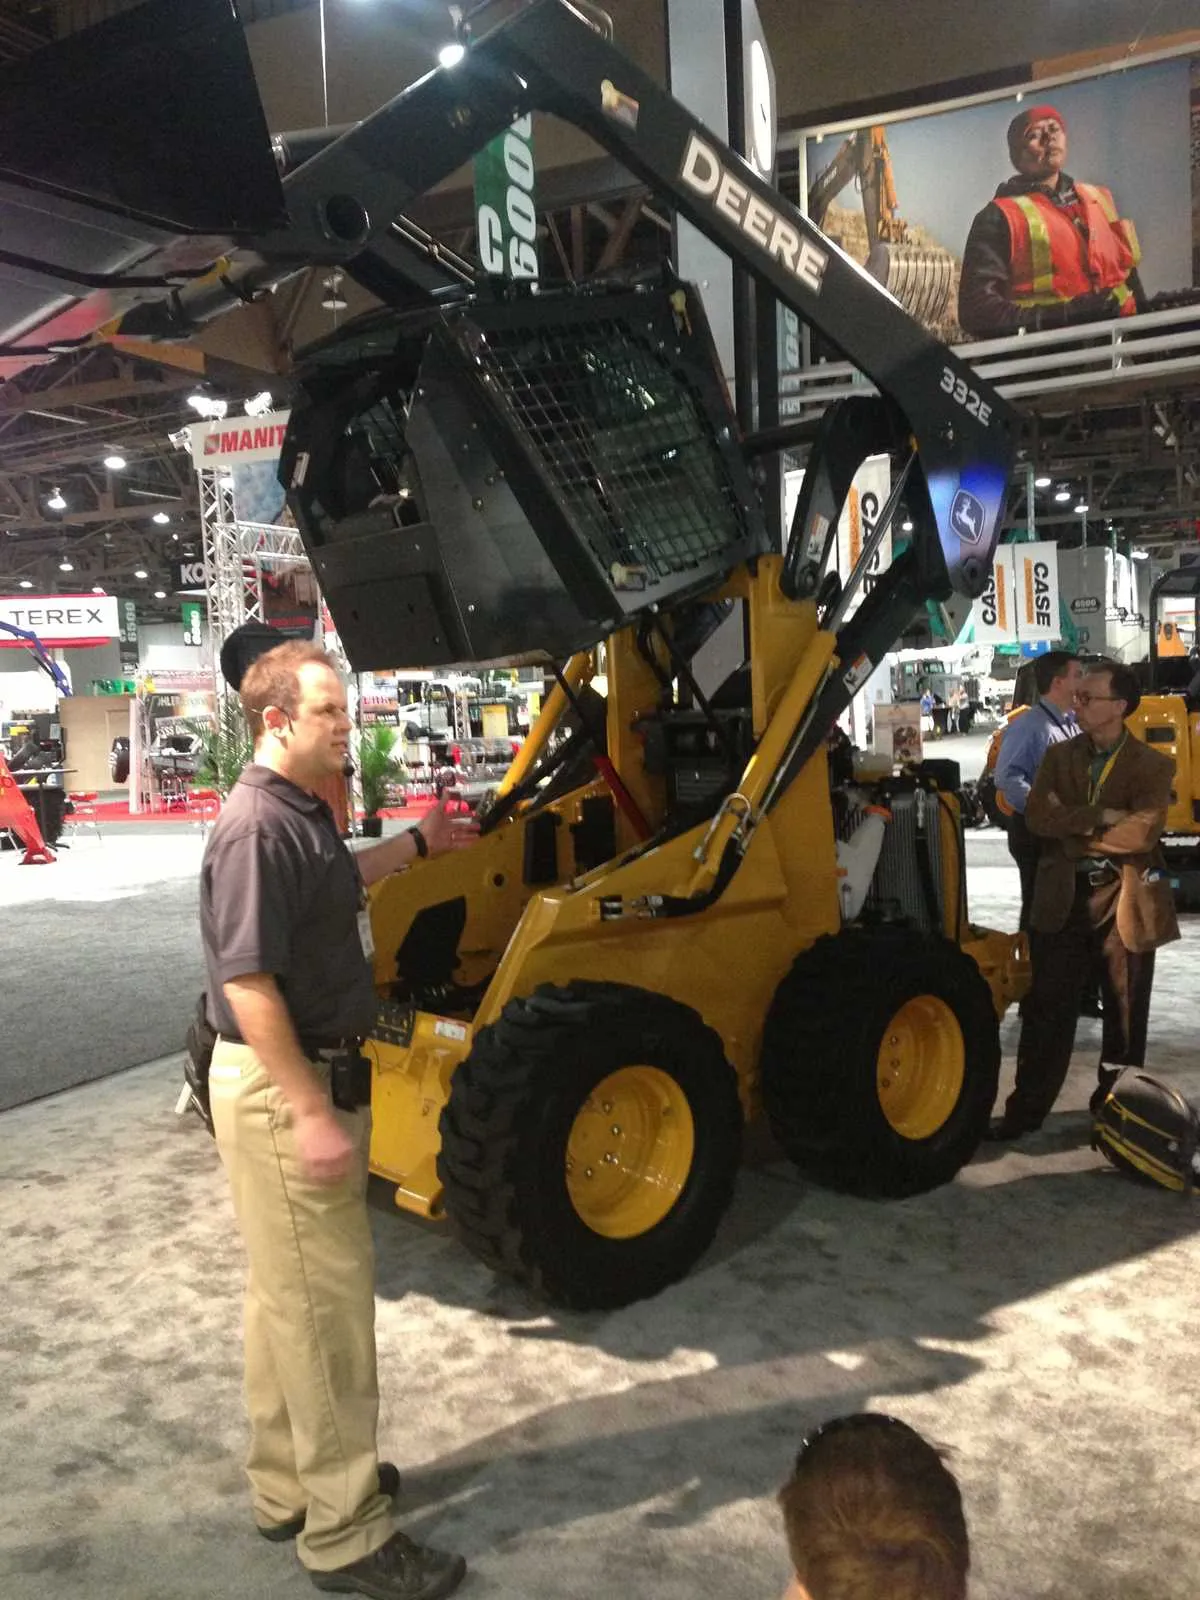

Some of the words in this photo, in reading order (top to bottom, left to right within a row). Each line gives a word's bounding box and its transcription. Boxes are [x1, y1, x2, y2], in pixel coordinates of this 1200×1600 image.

[682, 135, 827, 291] DEERE
[940, 366, 993, 427] 332E
[9, 608, 103, 626] TEREX
[1033, 562, 1051, 627] CASE
